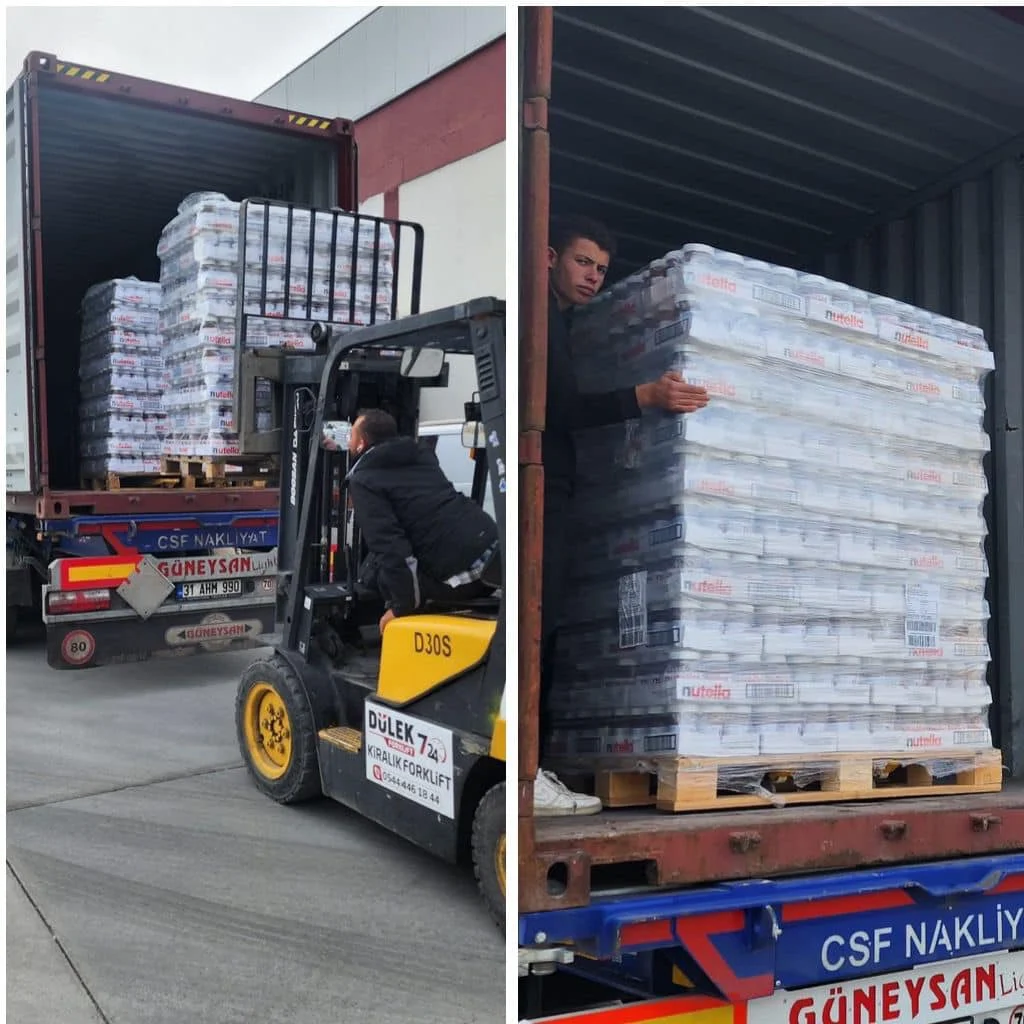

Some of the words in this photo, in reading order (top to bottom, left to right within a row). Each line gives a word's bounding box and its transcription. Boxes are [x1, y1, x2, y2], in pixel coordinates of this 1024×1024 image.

[826, 310, 864, 328] nutella
[895, 330, 929, 349] nutella
[784, 346, 825, 364] nutella
[213, 446, 240, 454] nutella
[158, 535, 188, 549] CSF
[158, 557, 250, 576] GÜNEYSAN
[909, 555, 944, 569] nutella
[183, 584, 194, 596] 31
[200, 582, 217, 594] AHM
[222, 580, 240, 592] 990
[682, 579, 733, 596] nutella
[187, 624, 244, 640] GÜNEYSAN
[71, 640, 86, 653] 80
[414, 631, 451, 657] D30S
[682, 685, 732, 700] nutella
[369, 710, 414, 745] DÜLEK
[907, 733, 942, 748] nutella
[367, 744, 402, 770] KİRALIK
[821, 927, 892, 972] CSF
[789, 964, 995, 1024] GÜNEYSAN
